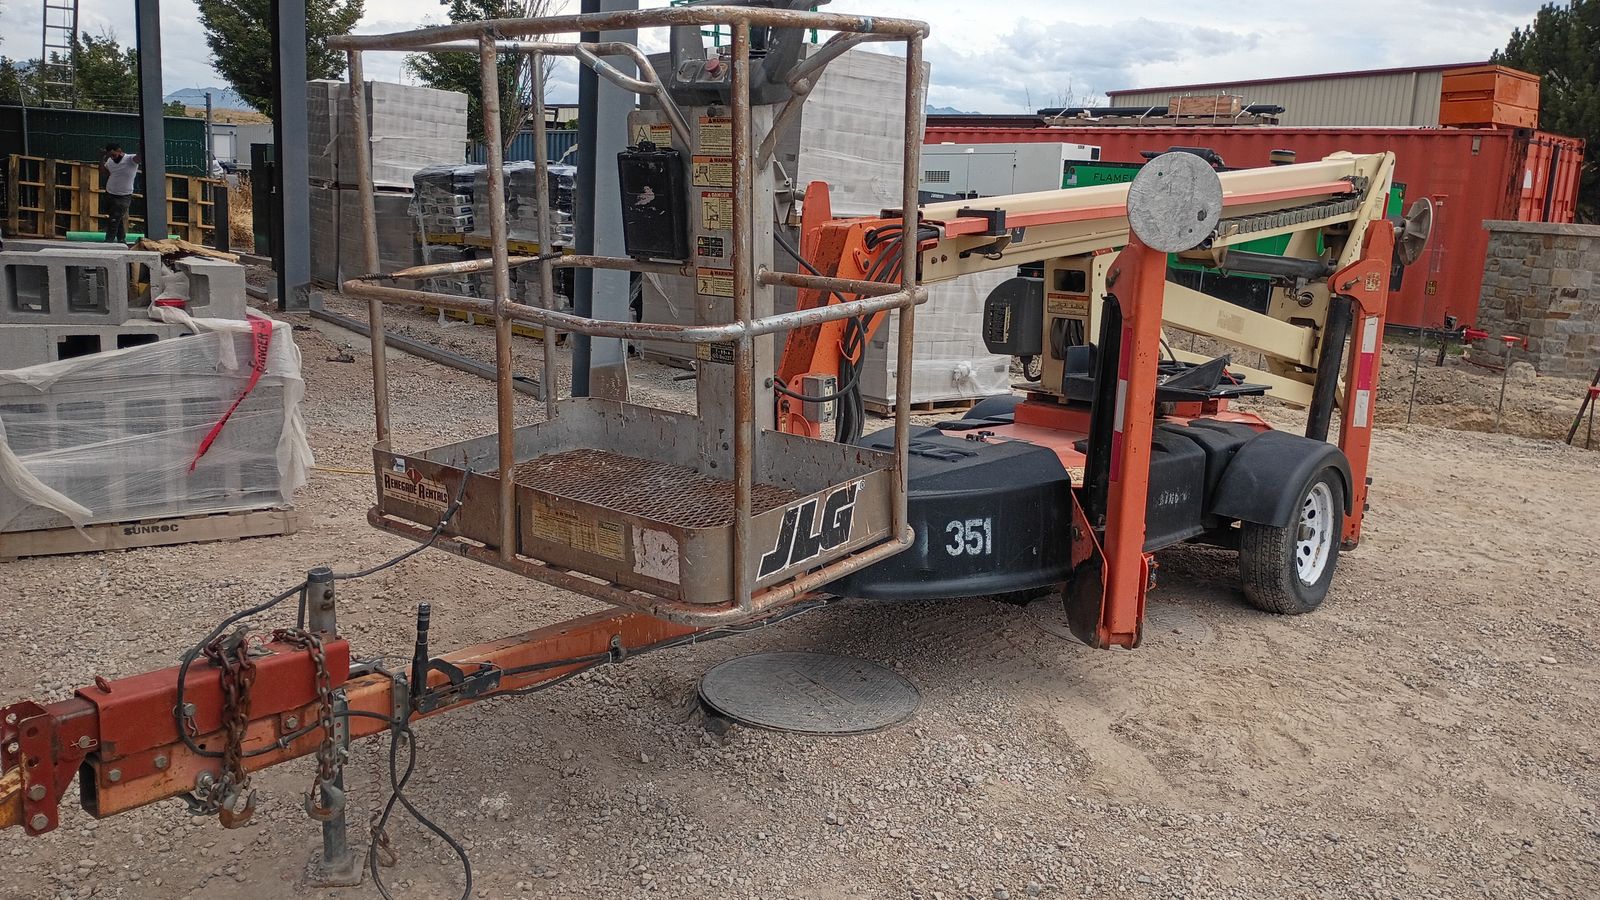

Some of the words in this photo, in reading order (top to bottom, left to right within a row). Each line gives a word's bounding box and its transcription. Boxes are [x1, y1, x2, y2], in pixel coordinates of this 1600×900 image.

[256, 332, 270, 372] DANGER
[384, 473, 417, 495] RENEGADE
[418, 483, 448, 504] RENTALS
[123, 524, 179, 536] SUNROC
[756, 480, 860, 582] JLG
[945, 517, 992, 556] 351
